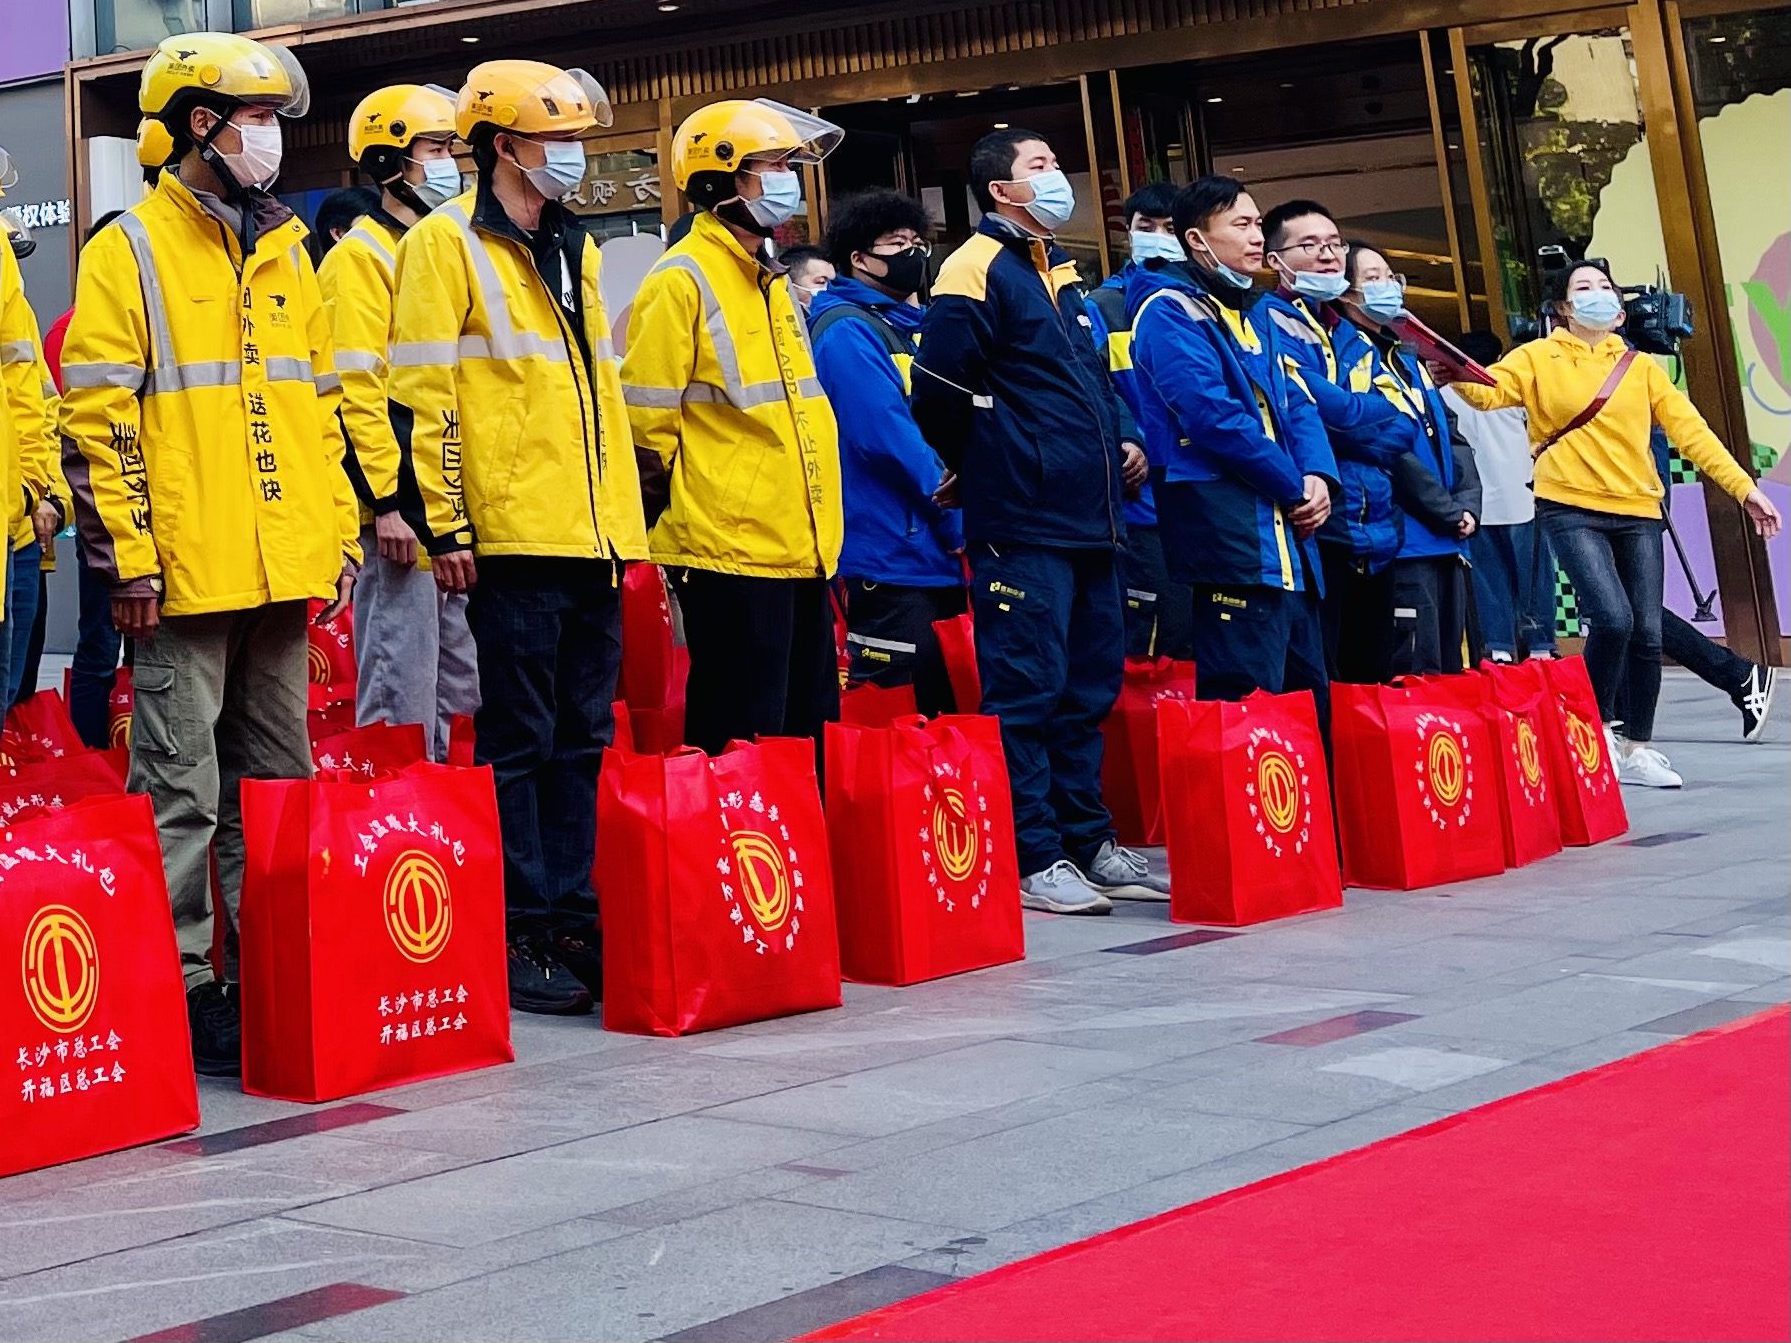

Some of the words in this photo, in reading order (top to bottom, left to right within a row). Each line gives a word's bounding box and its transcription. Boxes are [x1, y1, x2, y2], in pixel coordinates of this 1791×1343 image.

[249, 393, 282, 502] 送花也快
[354, 813, 466, 877] 工会温暖大礼包
[377, 983, 469, 1017] 长沙市总工会
[16, 1028, 122, 1071] 长沙市总工会
[379, 1011, 468, 1045] 开福区总工会
[21, 1060, 126, 1103] 开福区总工会
